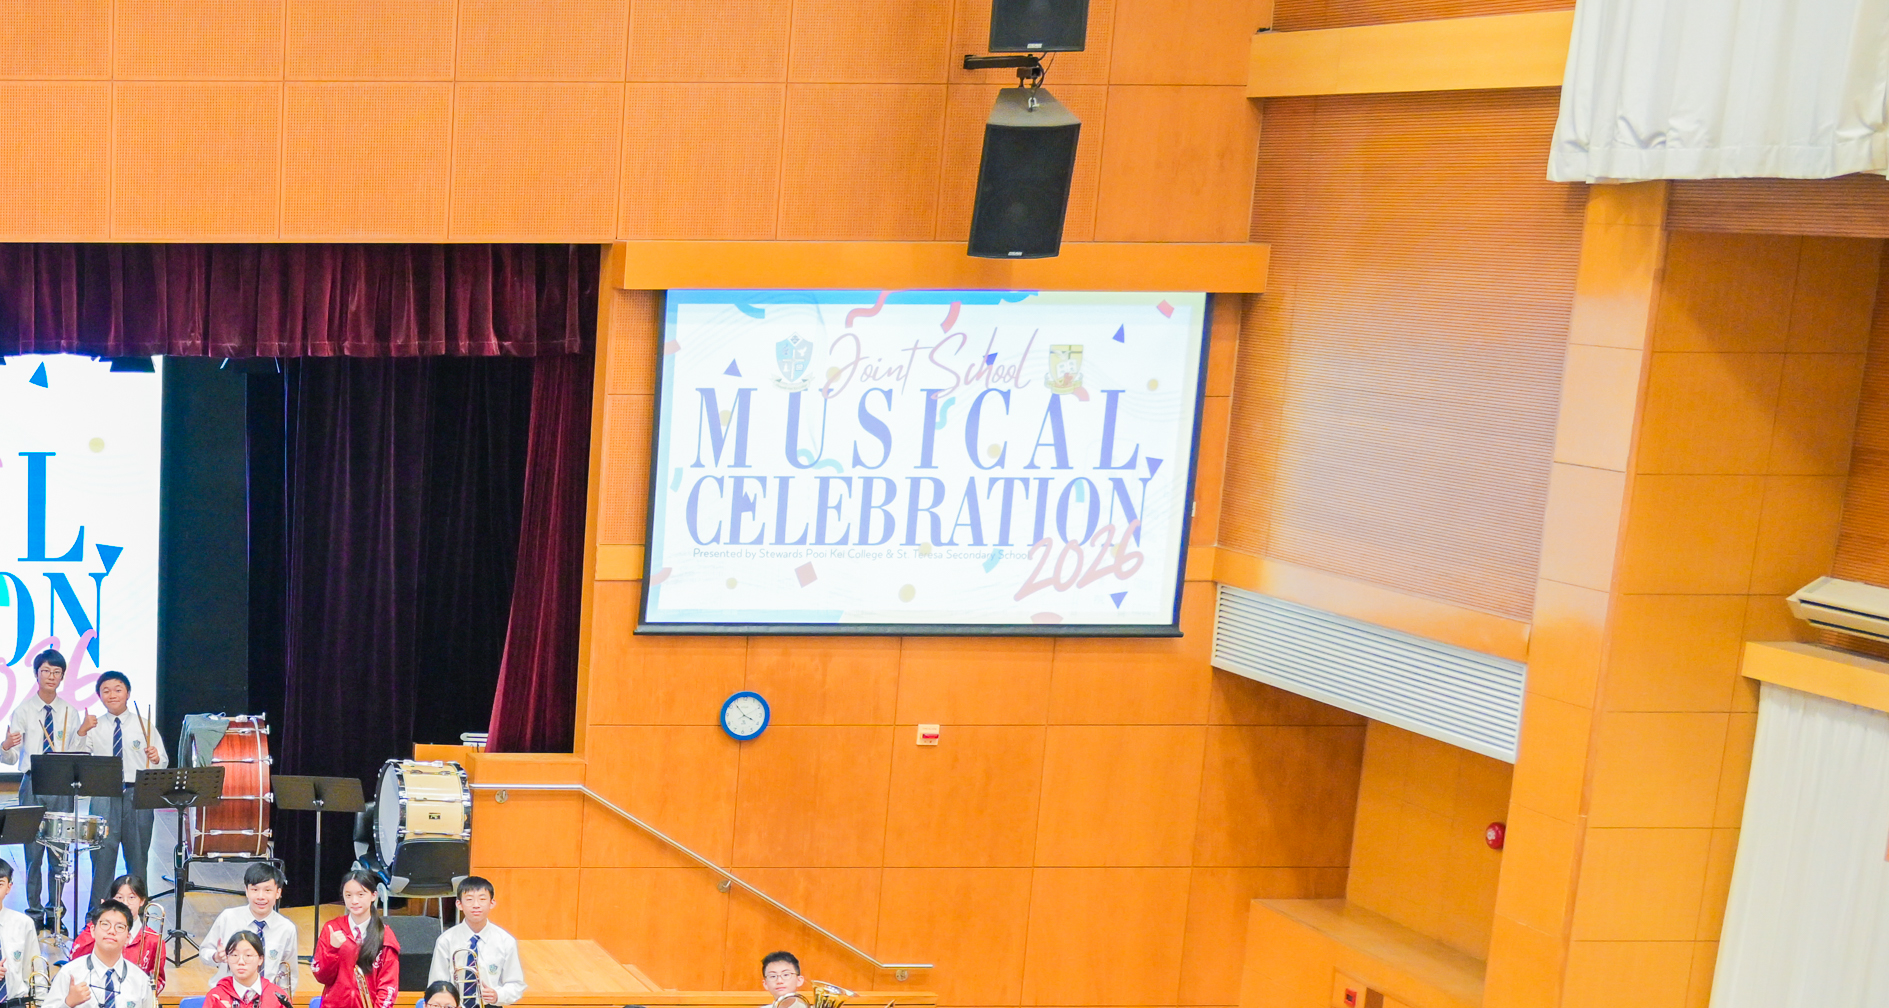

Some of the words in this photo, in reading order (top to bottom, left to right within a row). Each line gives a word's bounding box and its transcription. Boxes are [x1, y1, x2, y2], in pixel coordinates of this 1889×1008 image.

[822, 333, 933, 399] Joint
[928, 327, 1039, 400] School
[690, 387, 1139, 470] MUSICAL
[686, 475, 1150, 547] CELEBRATION
[693, 548, 743, 559] Presented
[745, 548, 757, 560] by
[759, 549, 802, 559] Stewards
[806, 549, 827, 559] Pooi
[830, 549, 845, 559] Kei
[847, 549, 883, 561] College
[885, 549, 894, 559] &
[897, 550, 909, 559] St.
[913, 550, 943, 559] Teresa
[946, 550, 996, 561] Secondary
[999, 550, 1030, 559] School
[1013, 519, 1144, 602] 2026
